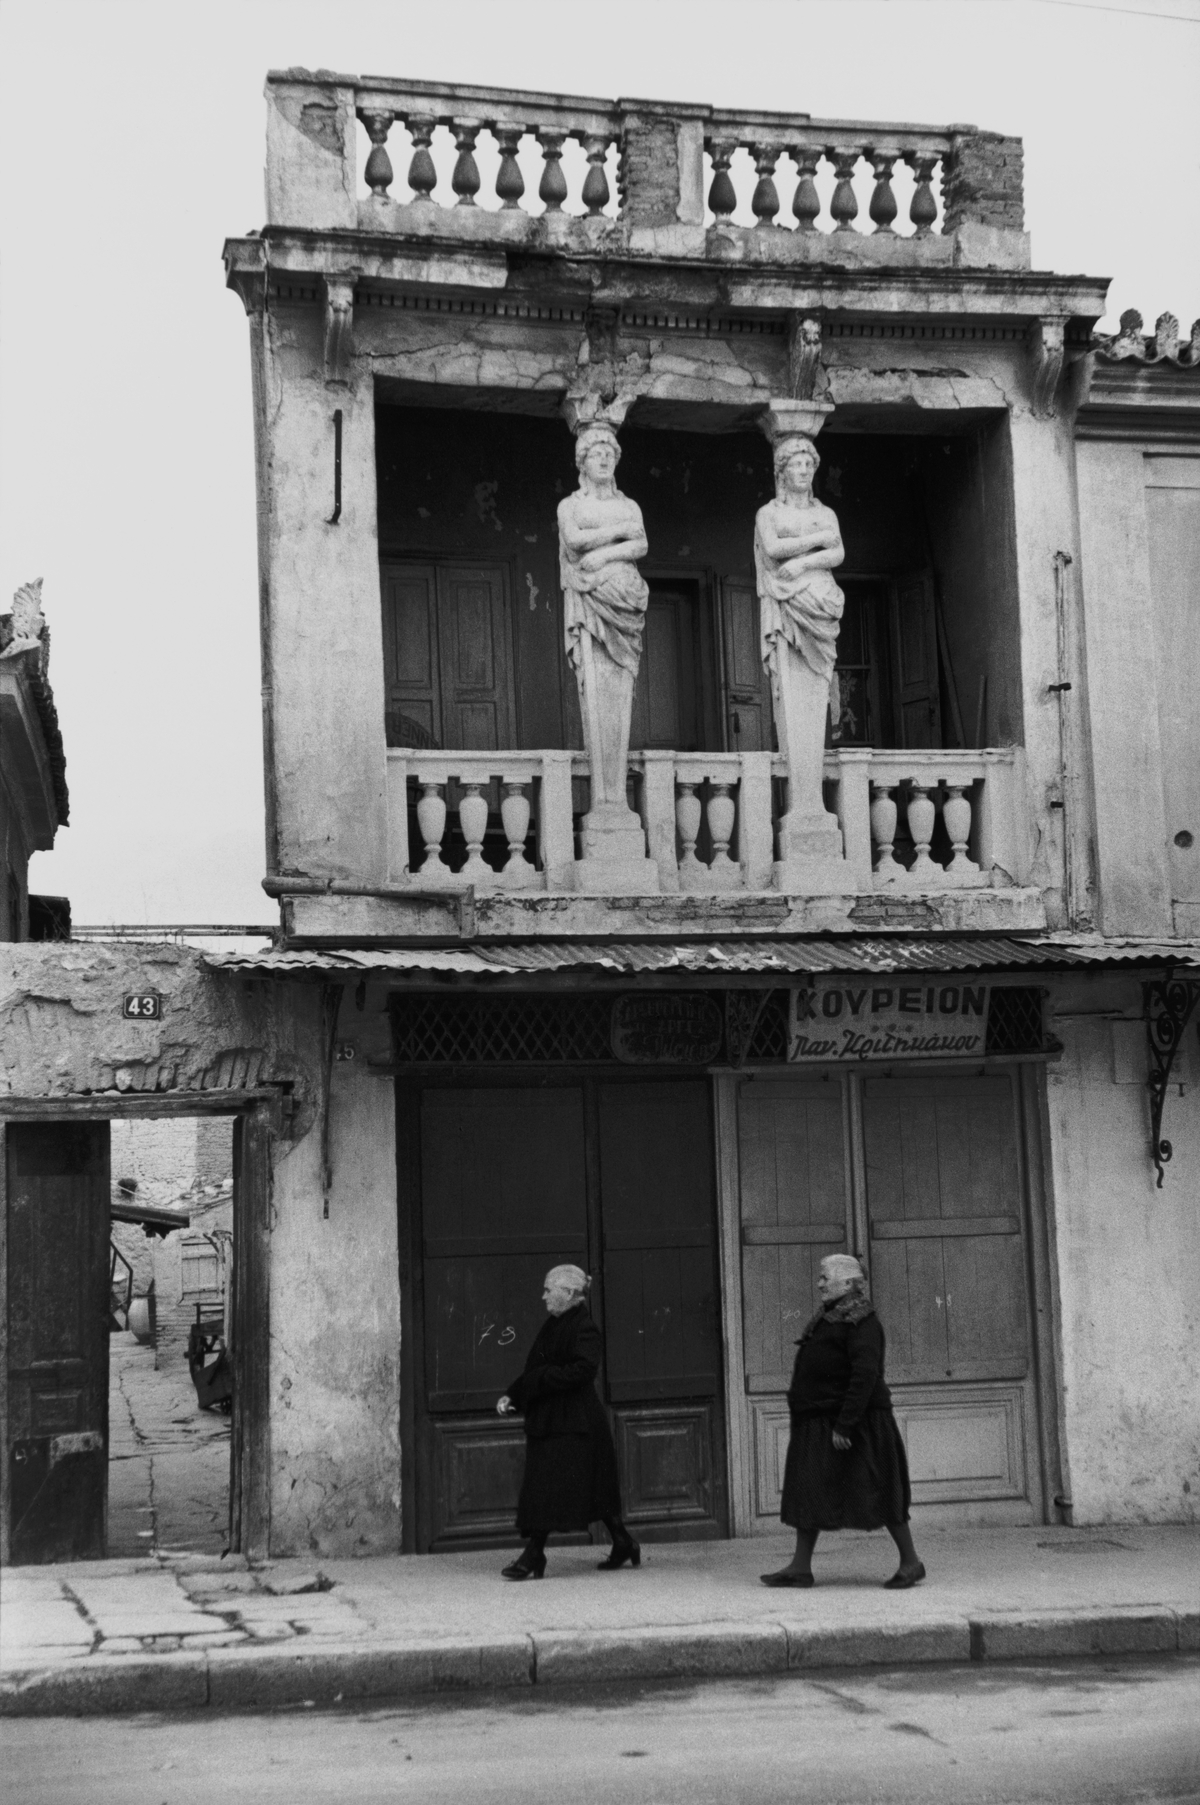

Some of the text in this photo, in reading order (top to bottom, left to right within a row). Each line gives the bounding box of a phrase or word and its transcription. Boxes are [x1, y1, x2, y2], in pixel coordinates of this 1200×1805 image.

[128, 997, 154, 1015] 43
[796, 985, 986, 1021] ΚΟΥΡΕΙΟΝ
[790, 1034, 839, 1061] Παν.
